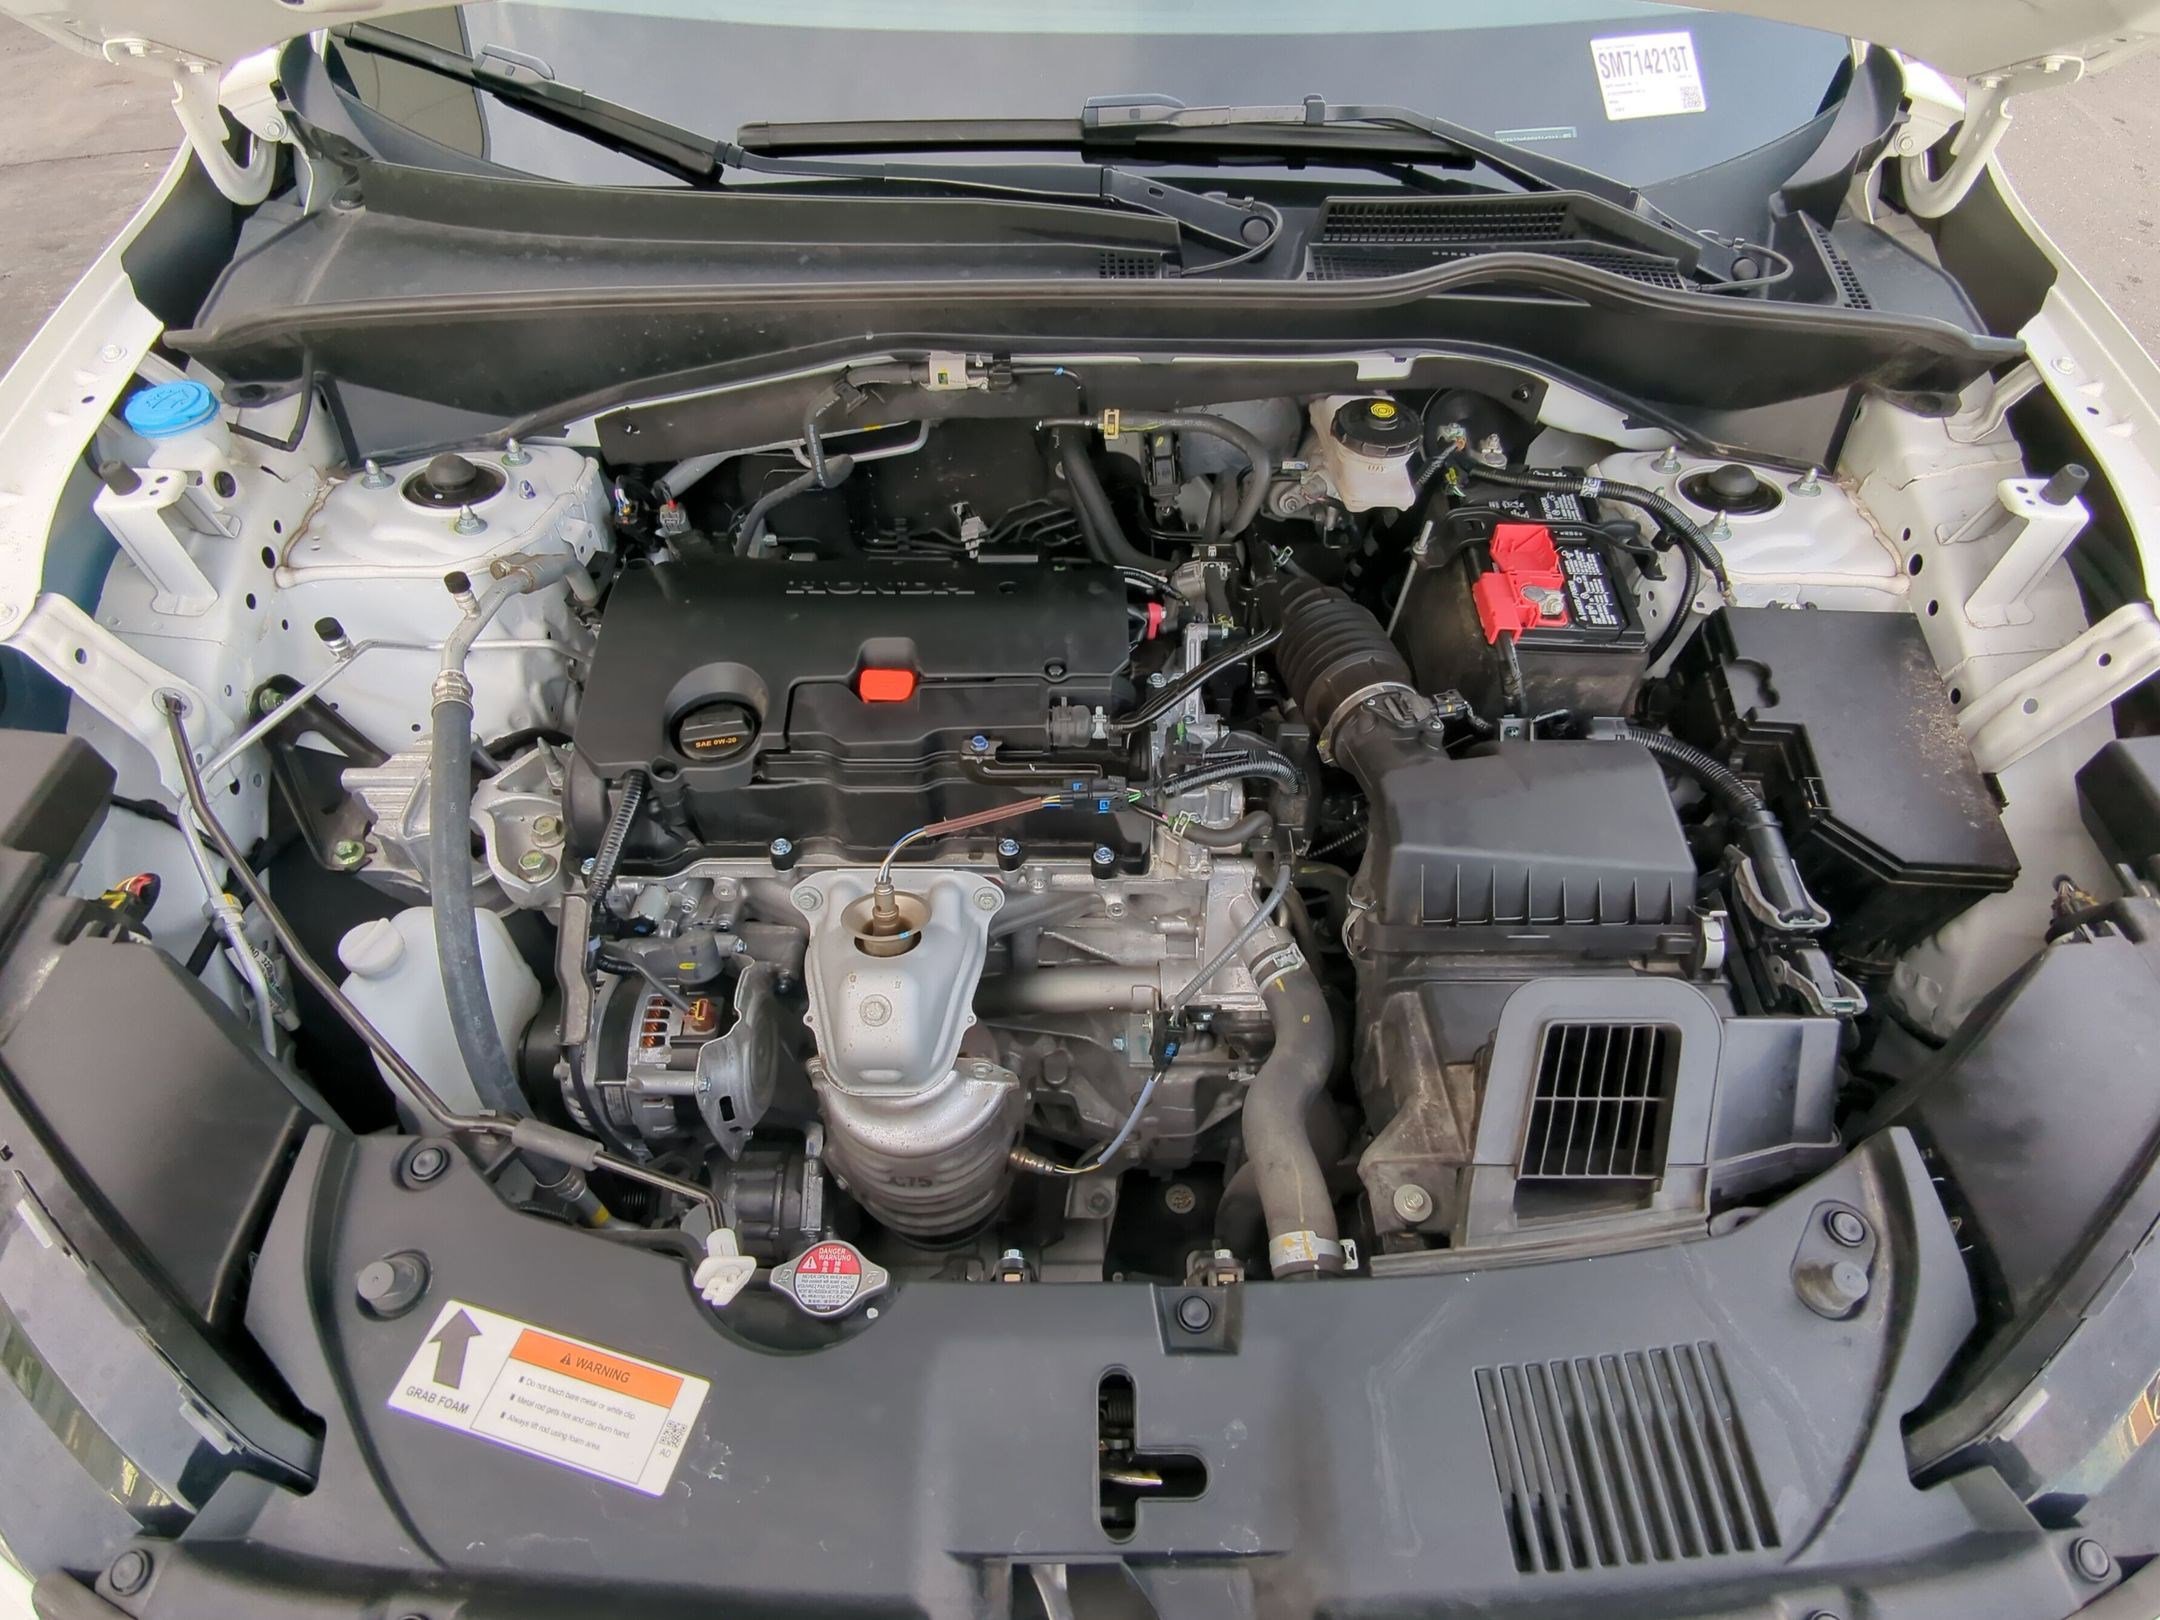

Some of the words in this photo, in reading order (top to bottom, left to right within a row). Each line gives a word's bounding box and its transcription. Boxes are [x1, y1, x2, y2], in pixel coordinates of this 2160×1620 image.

[1598, 46, 1689, 79] SM714213T
[695, 740, 712, 749] SAE
[713, 737, 737, 746] 0W-20
[818, 1247, 847, 1255] DANGER
[576, 1357, 631, 1383] WARNING
[406, 1385, 437, 1404] GRAB
[437, 1395, 470, 1415] FOAM
[526, 1377, 535, 1387] Do
[536, 1382, 547, 1391] not
[547, 1385, 565, 1397] touch
[580, 1396, 599, 1408] metal
[517, 1395, 536, 1407] Metal
[535, 1402, 547, 1412] rod
[560, 1410, 572, 1420] hot
[572, 1414, 586, 1425] and
[507, 1413, 530, 1428] Always
[530, 1420, 539, 1430] lift
[538, 1424, 551, 1435] rod
[550, 1429, 569, 1442] using
